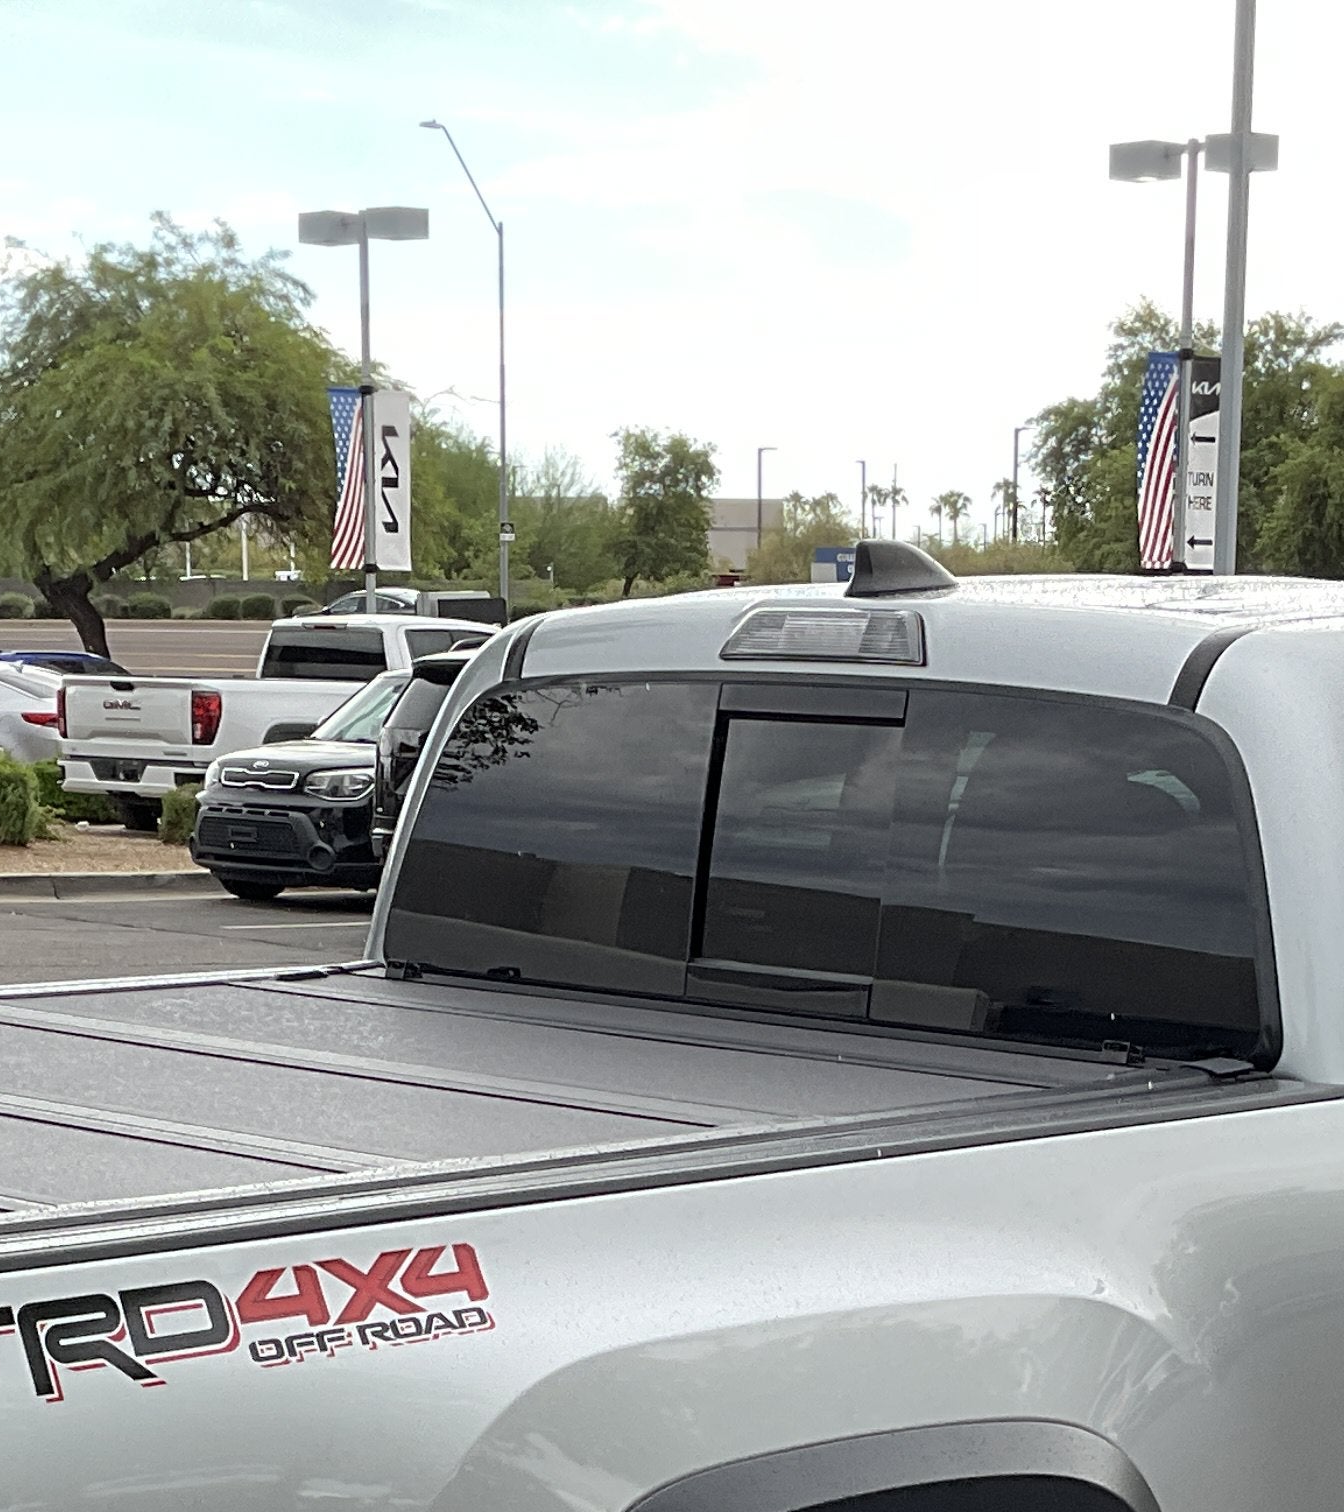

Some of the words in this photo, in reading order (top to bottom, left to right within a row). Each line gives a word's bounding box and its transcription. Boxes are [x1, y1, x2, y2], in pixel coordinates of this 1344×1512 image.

[1188, 472, 1214, 487] TURN
[1188, 496, 1212, 511] HERE
[248, 1326, 354, 1367] OFF
[356, 1305, 496, 1350] ROAD
